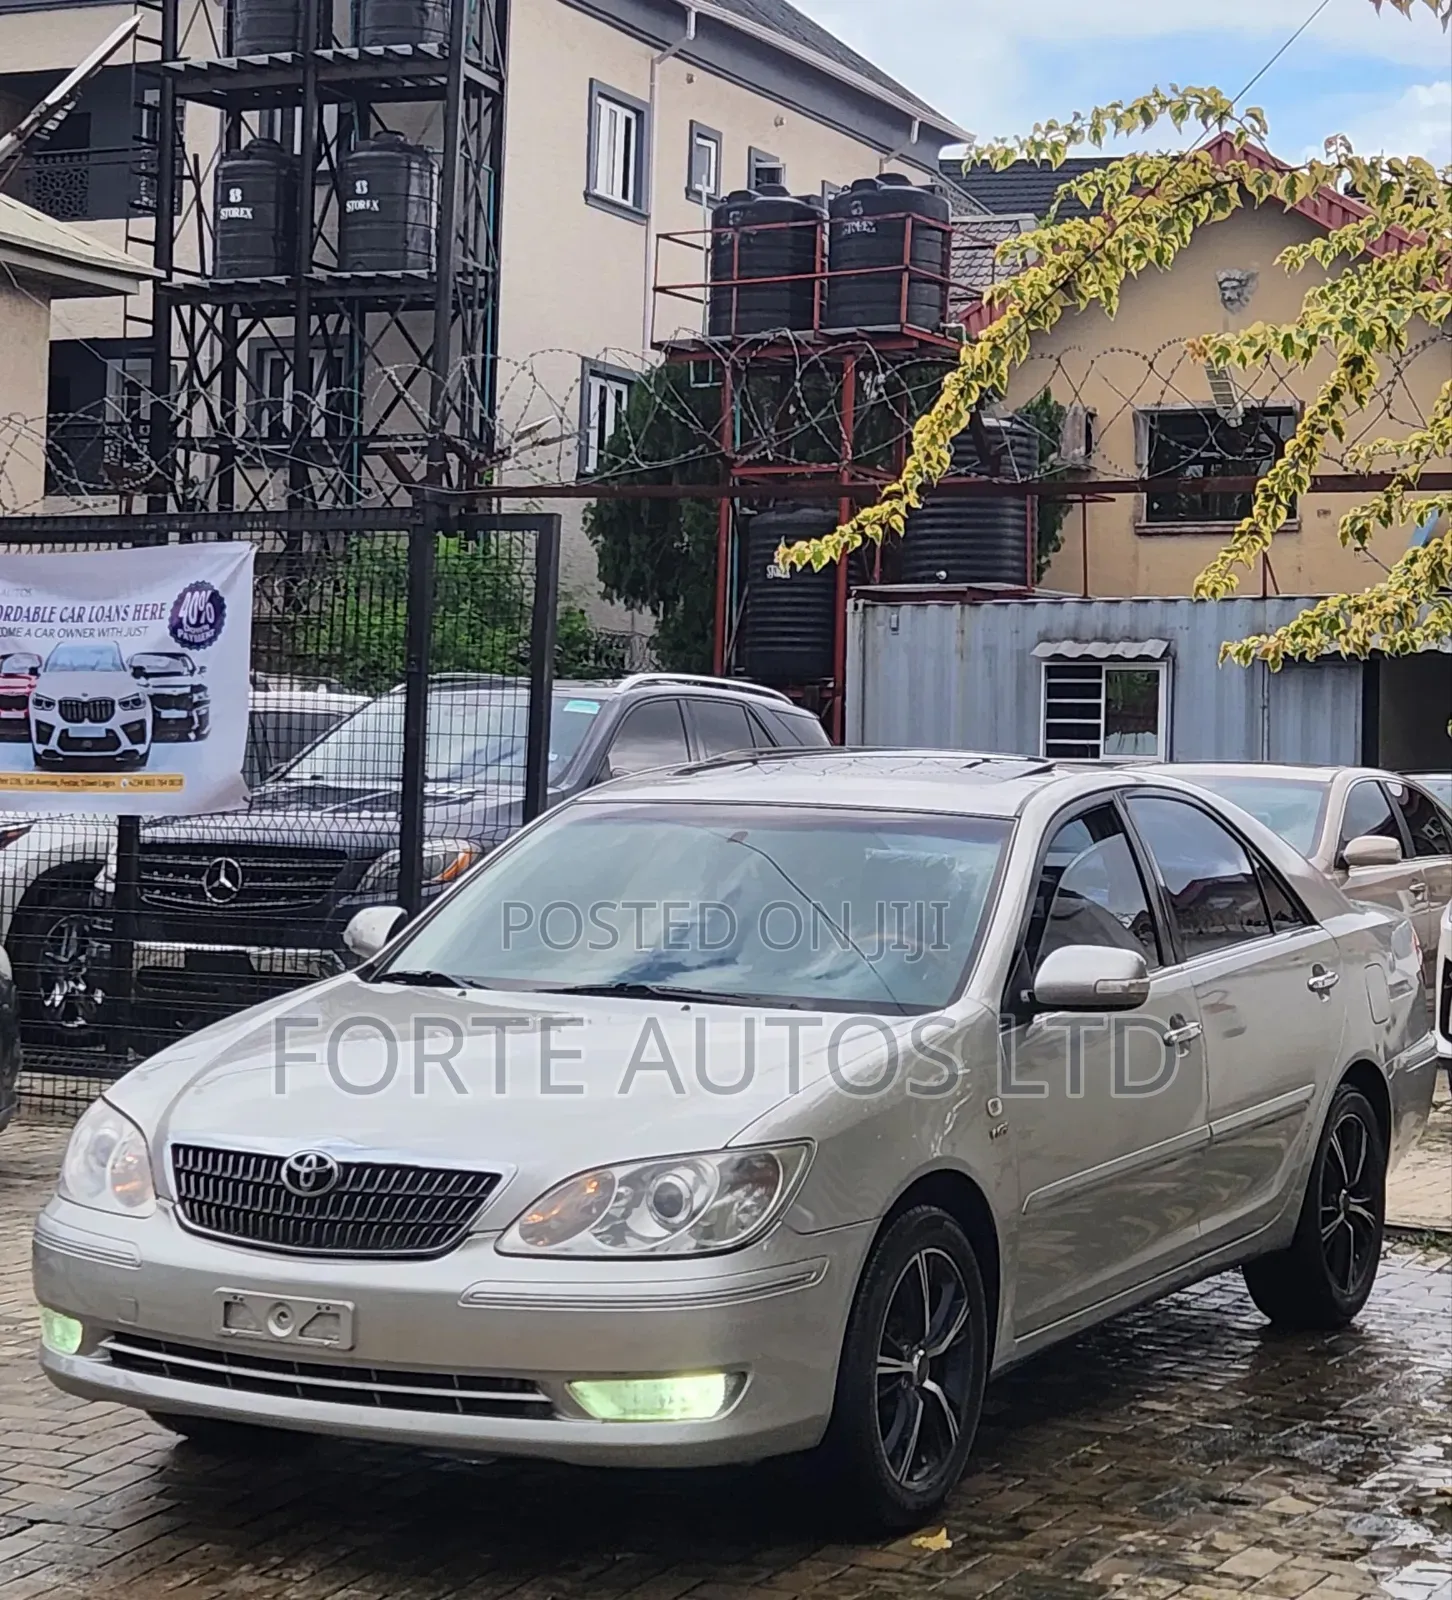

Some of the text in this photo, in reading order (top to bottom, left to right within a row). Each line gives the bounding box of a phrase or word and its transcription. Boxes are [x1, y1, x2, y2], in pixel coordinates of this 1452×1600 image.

[219, 207, 254, 220] STOREX
[59, 606, 86, 623] CAR
[88, 604, 130, 623] LOANS
[132, 602, 167, 621] HERE
[178, 590, 215, 625] 40%
[24, 628, 32, 638] A
[34, 628, 55, 638] CAR
[57, 627, 95, 639] OWNER
[97, 626, 123, 638] WITH
[123, 625, 149, 637] JUST
